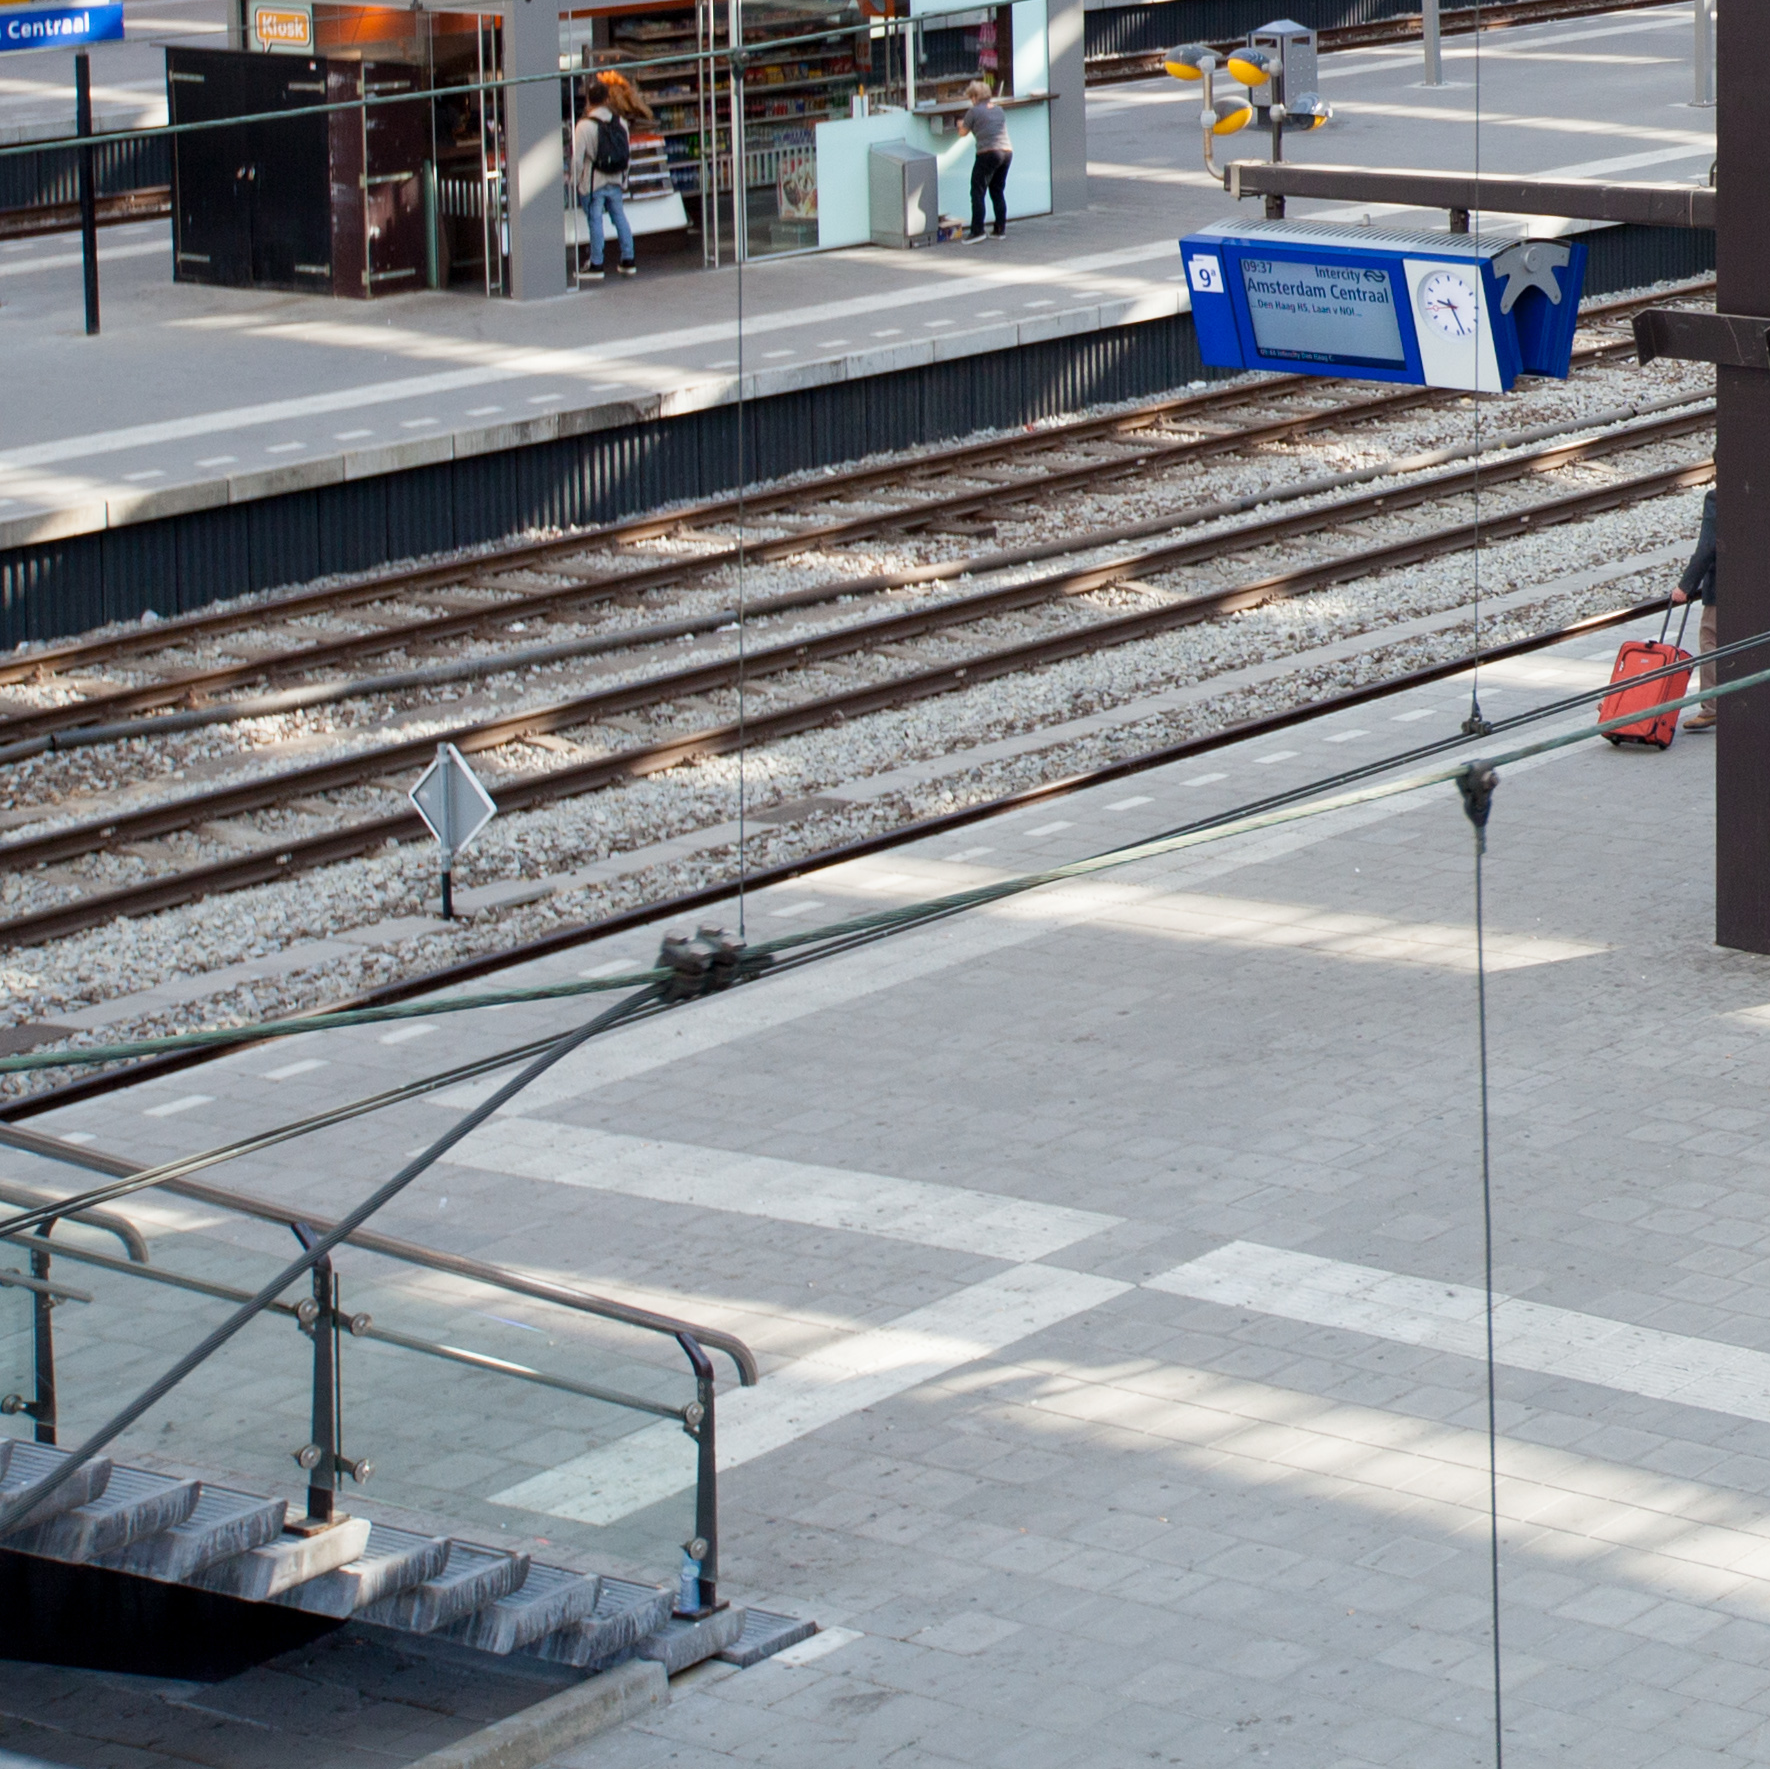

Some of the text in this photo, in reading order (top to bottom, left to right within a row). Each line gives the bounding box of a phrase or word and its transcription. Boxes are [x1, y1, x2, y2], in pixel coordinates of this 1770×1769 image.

[8, 11, 90, 39] Centraal
[261, 14, 305, 38] Kiosk
[1243, 260, 1361, 283] 09:37 Intercity
[1247, 277, 1390, 304] Amsterdam Centraal
[1275, 301, 1296, 313] Haag
[1312, 305, 1331, 315] Laan
